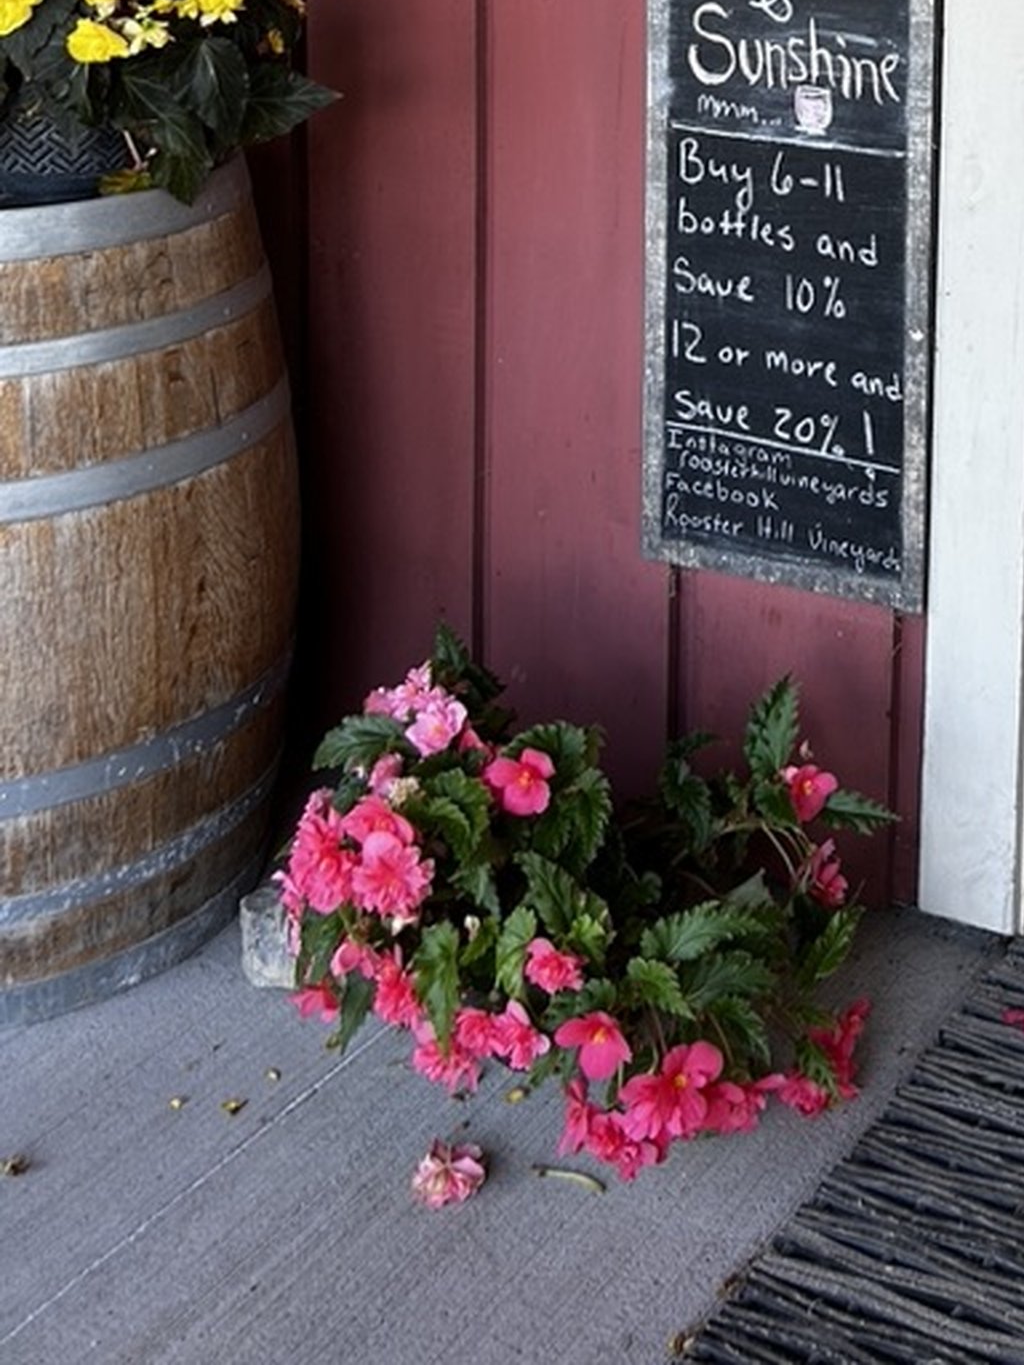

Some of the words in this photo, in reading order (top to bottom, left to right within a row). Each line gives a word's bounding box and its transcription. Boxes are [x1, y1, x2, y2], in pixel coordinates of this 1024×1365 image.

[687, 2, 901, 106] Sunshine
[679, 137, 753, 212] Buy
[771, 150, 845, 203] 6-11
[678, 196, 796, 252] bottles
[816, 234, 879, 267] and
[673, 256, 755, 302] Save
[785, 274, 846, 319] 10%
[672, 319, 707, 364] 12
[718, 346, 750, 366] or
[765, 349, 838, 387] more
[851, 372, 904, 403] and
[674, 390, 751, 431] Save
[667, 428, 792, 470] Instagram
[664, 491, 744, 536] Rooster
[757, 515, 794, 543] Hill
[665, 471, 780, 511] Facebook
